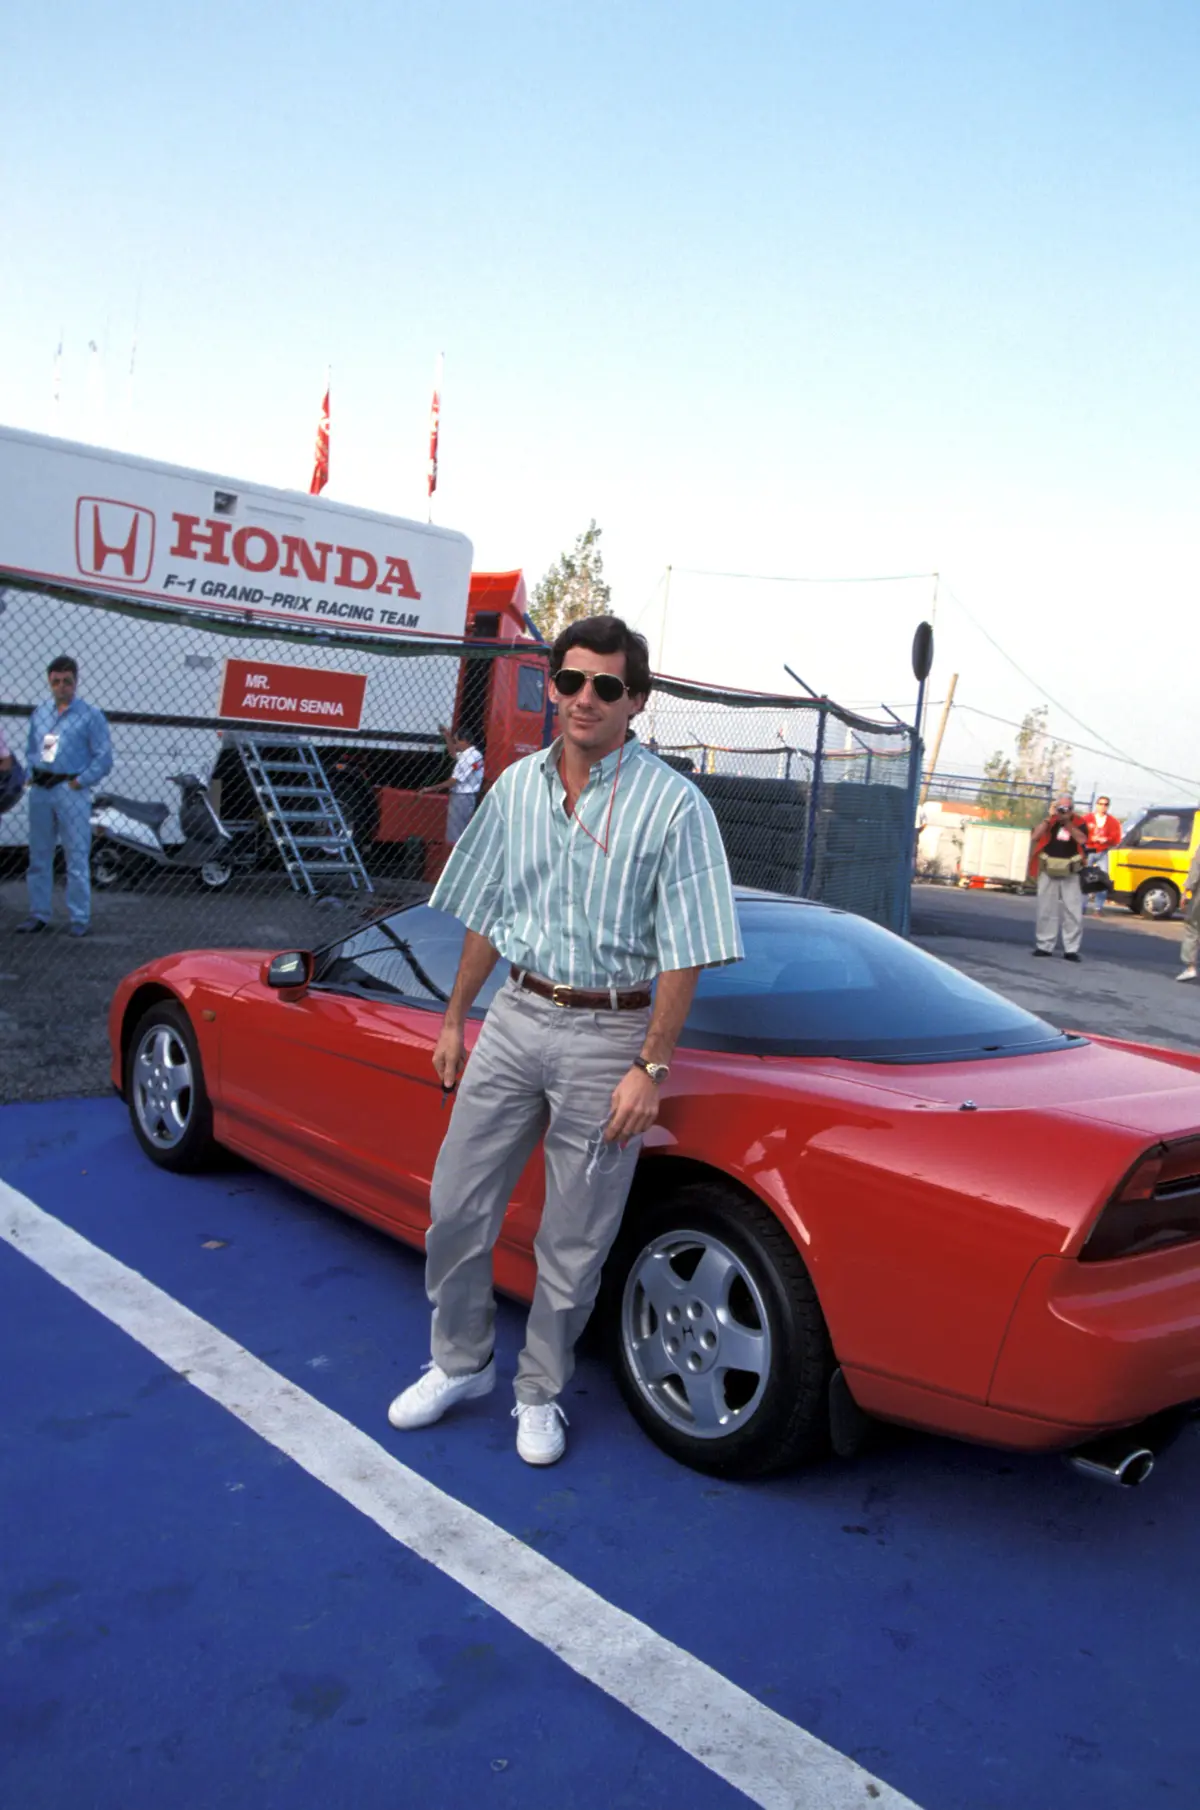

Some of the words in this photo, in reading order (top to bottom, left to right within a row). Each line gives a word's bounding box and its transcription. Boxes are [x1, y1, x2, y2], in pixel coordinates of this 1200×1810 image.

[169, 511, 421, 600] HONDA
[162, 574, 197, 593] F-1
[200, 580, 313, 611] GRAND-PRIX
[315, 599, 374, 621] RACING
[379, 609, 420, 628] TEAM
[244, 673, 271, 689] MR.
[241, 693, 297, 711] AYRTON
[299, 699, 344, 716] SENNA
